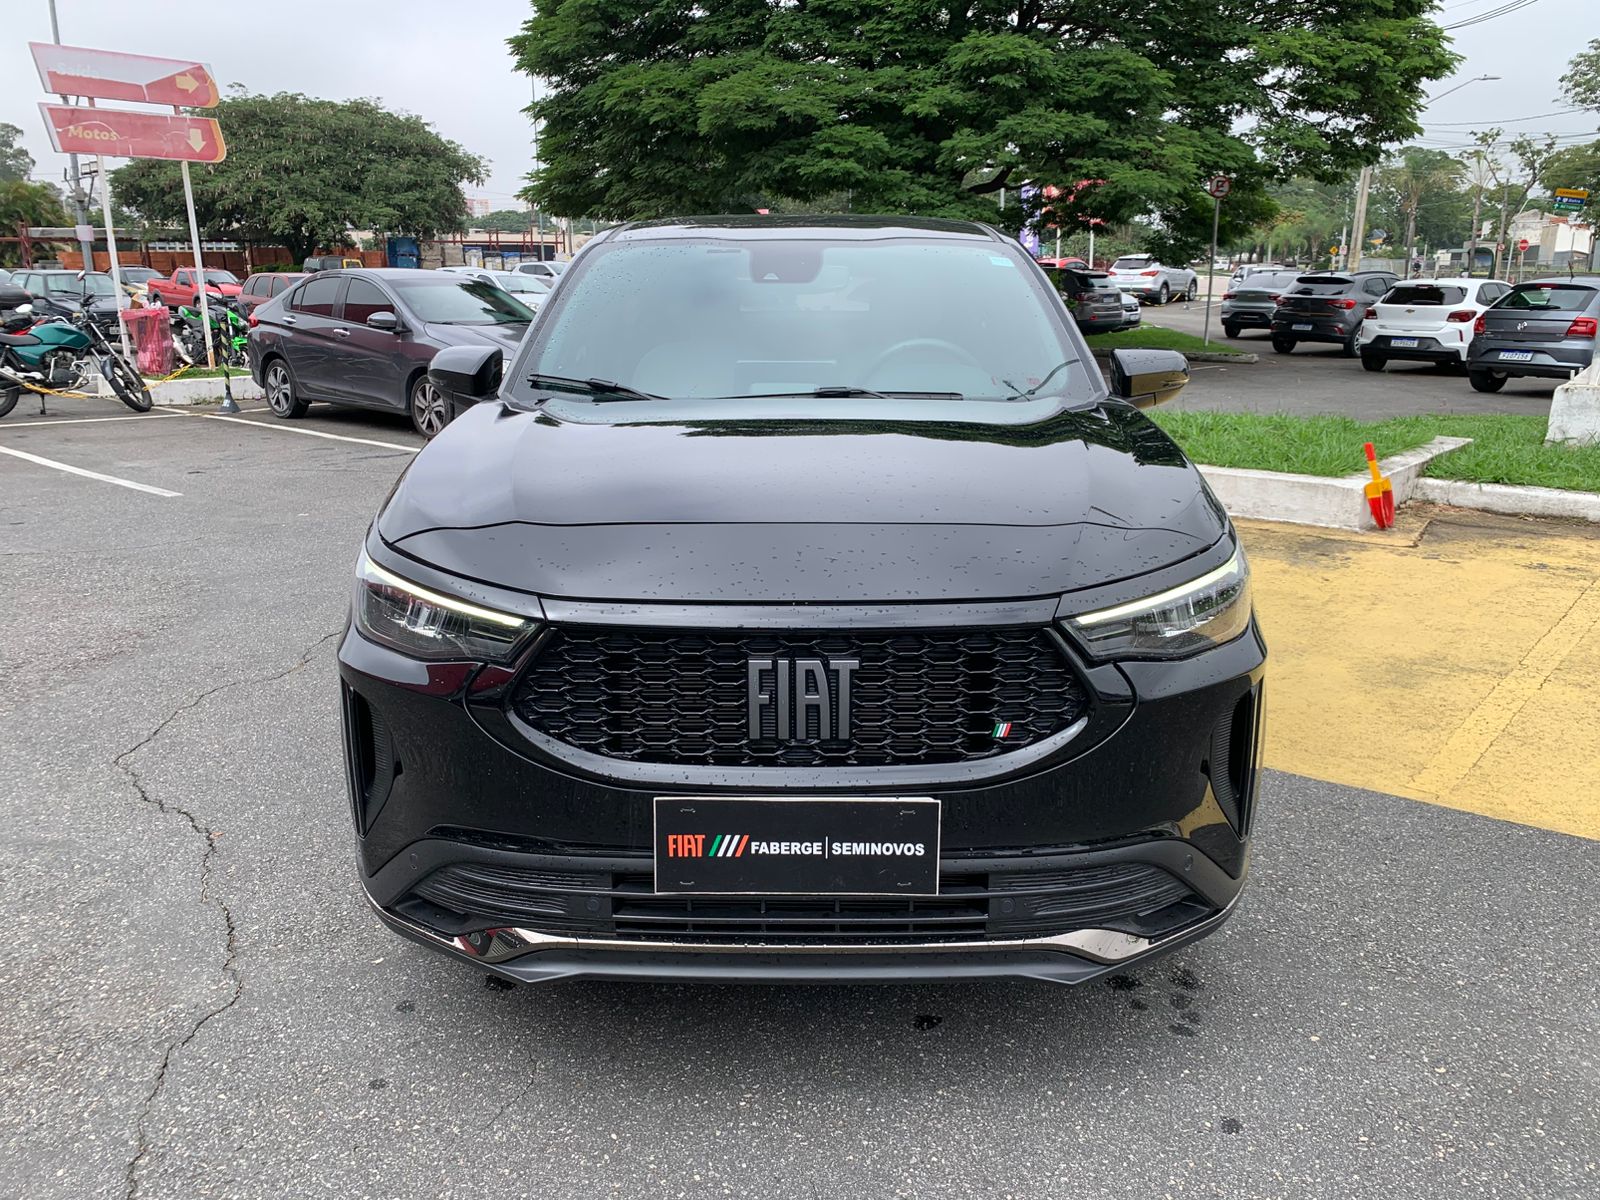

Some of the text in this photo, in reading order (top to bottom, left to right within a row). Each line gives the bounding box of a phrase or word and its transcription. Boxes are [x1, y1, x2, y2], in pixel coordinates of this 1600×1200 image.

[67, 126, 118, 141] Motos
[748, 660, 859, 740] FIAT
[668, 834, 925, 857] FIAT FABERGE SEMINOVOS
